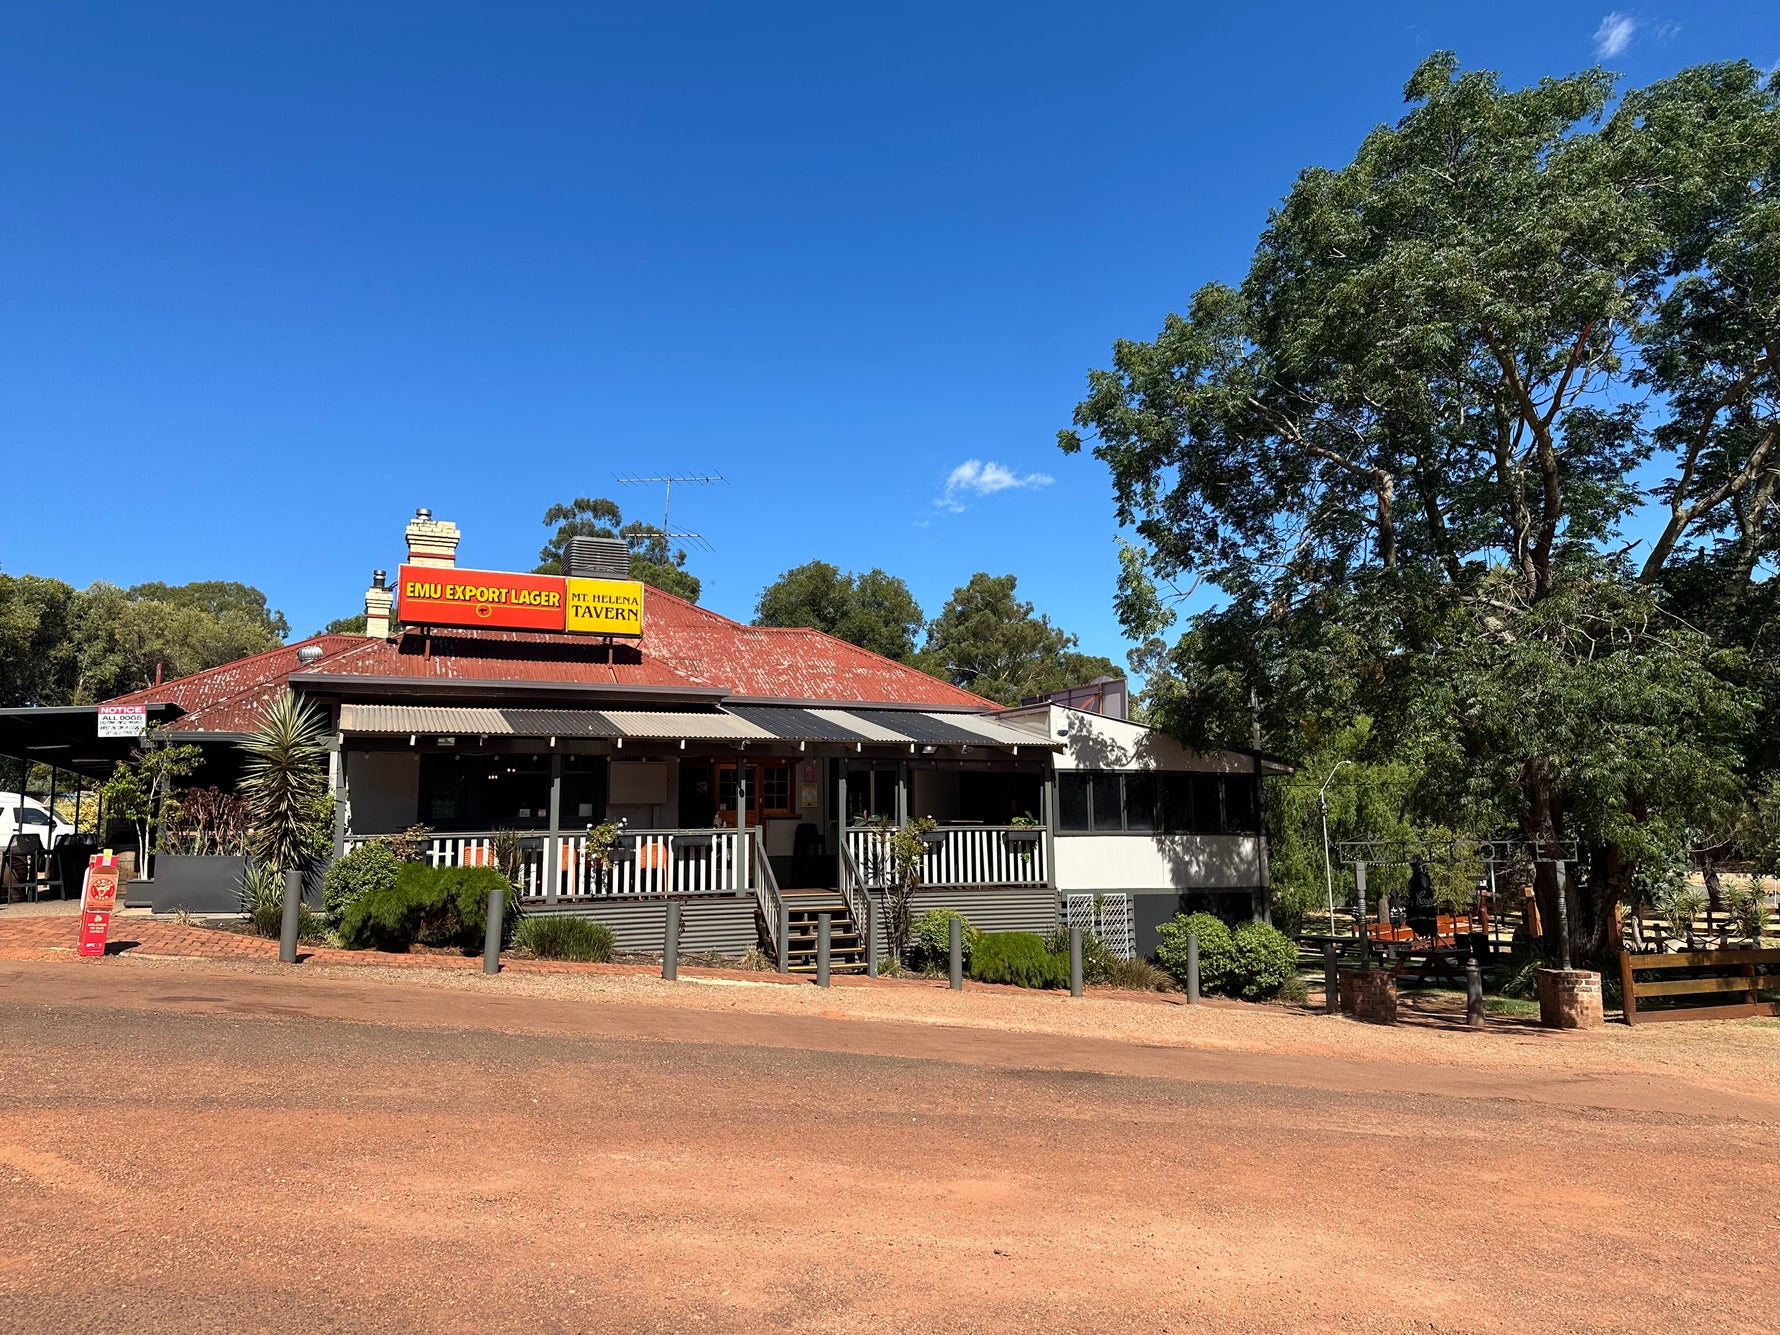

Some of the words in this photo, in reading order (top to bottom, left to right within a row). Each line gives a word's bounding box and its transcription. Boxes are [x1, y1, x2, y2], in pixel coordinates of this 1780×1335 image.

[405, 581, 442, 600] EMU
[445, 584, 509, 603] EXPORT
[511, 588, 560, 607] LAGER
[571, 592, 590, 602] MT.
[592, 594, 639, 606] HELENA
[571, 605, 639, 621] TAVERN
[101, 706, 142, 714] NOTICE
